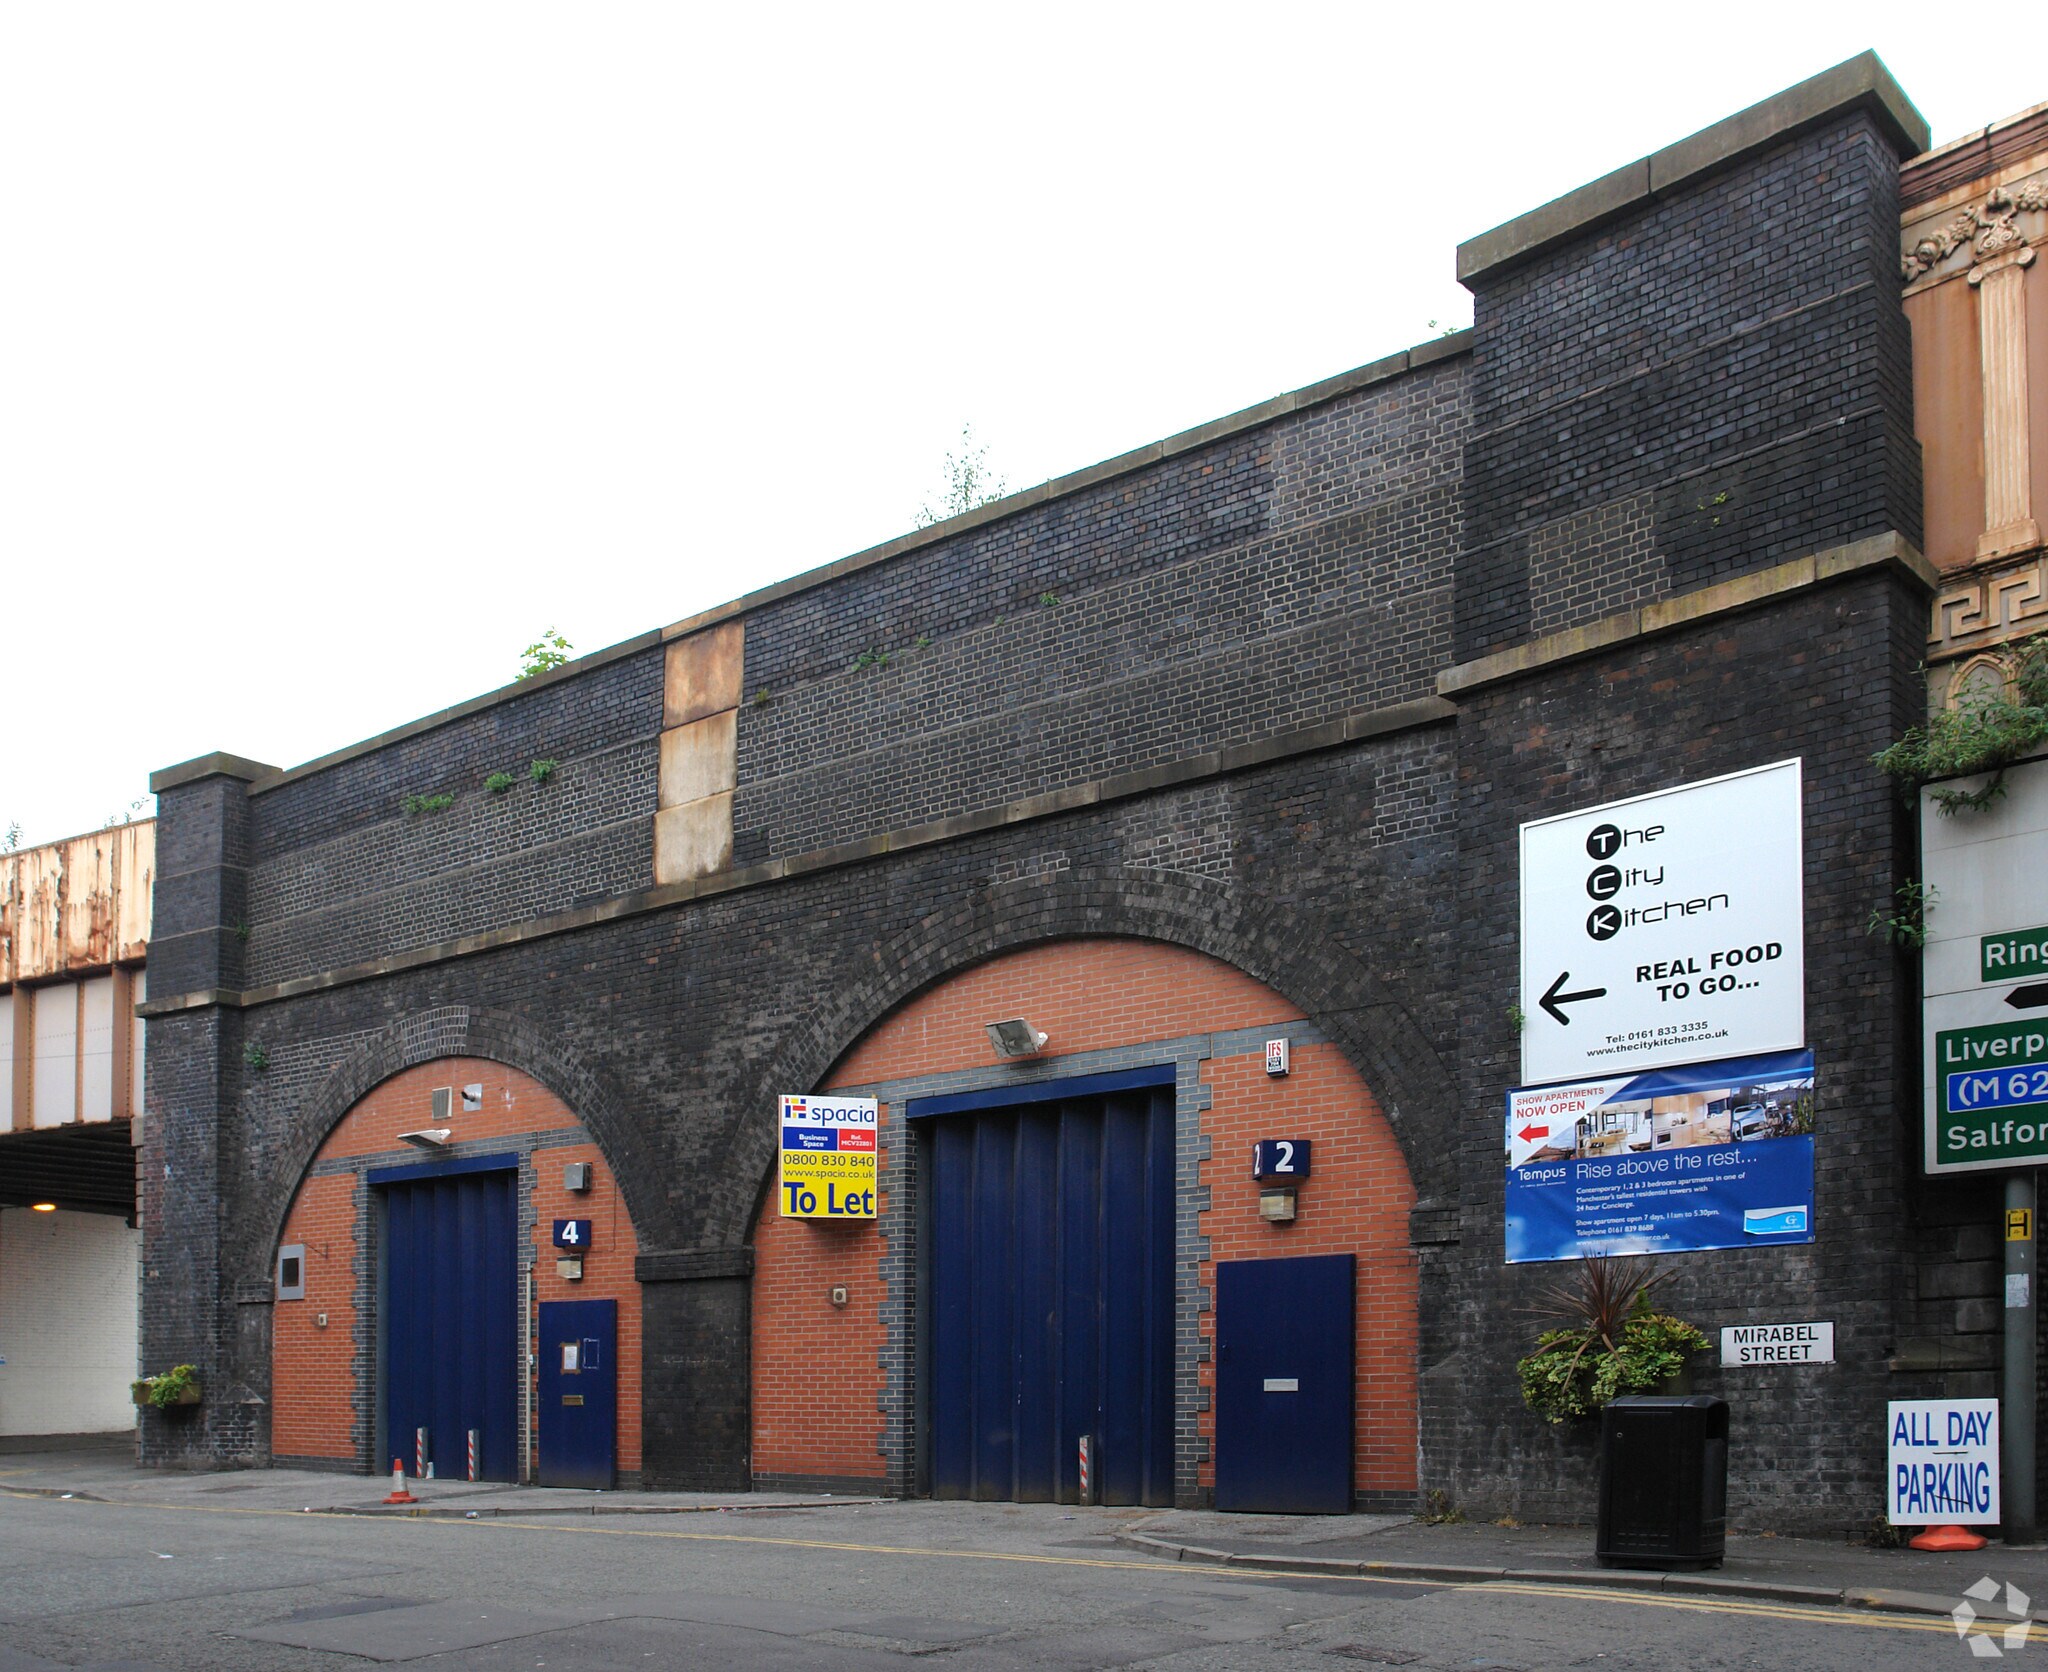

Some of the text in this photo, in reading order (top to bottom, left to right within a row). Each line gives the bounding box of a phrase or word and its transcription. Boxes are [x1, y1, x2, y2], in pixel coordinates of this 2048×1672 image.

[1586, 823, 1665, 861] The
[1586, 864, 1664, 901] City
[1586, 893, 1729, 941] Kitchen
[1636, 942, 1783, 983] REAL FOOD
[1657, 974, 1760, 1002] TO GO...
[1586, 1028, 1730, 1058] www.thecitykitchen.co.uk
[1605, 1020, 1709, 1045] Tel: 0161 833 3335
[1268, 1041, 1282, 1057] IFS
[1946, 1035, 2048, 1063] Liverp
[1516, 1087, 1605, 1106] SHOW APARTMENTS
[811, 1105, 875, 1127] spacia
[1516, 1100, 1586, 1119] NOW OPEN
[798, 1133, 829, 1141] Business
[803, 1140, 825, 1148] Space
[783, 1154, 875, 1167] 0800 830 840
[1254, 1143, 1261, 1175] 2
[1275, 1141, 1294, 1173] 2
[1576, 1149, 1757, 1180] Rise above the rest...
[784, 1169, 875, 1179] www.spacia.co.uk
[1517, 1167, 1567, 1182] Tempus
[1576, 1185, 1622, 1195] Contemporary
[1647, 1179, 1677, 1188] bedroom
[1678, 1175, 1714, 1186] apartments
[783, 1181, 874, 1215] To Let
[1669, 1187, 1693, 1195] towers
[1585, 1203, 1600, 1211] hour
[1576, 1228, 1607, 1237] Telephone
[1607, 1226, 1623, 1234] 0161
[1593, 1216, 1626, 1226] apartment
[1626, 1215, 1643, 1223] open
[2007, 1212, 2028, 1238] H
[562, 1221, 579, 1244] 4
[1733, 1325, 1819, 1344] MIRABEL
[1740, 1344, 1812, 1362] STREET
[1892, 1410, 1993, 1447] ALL DAY
[1897, 1461, 1991, 1515] PARKING
